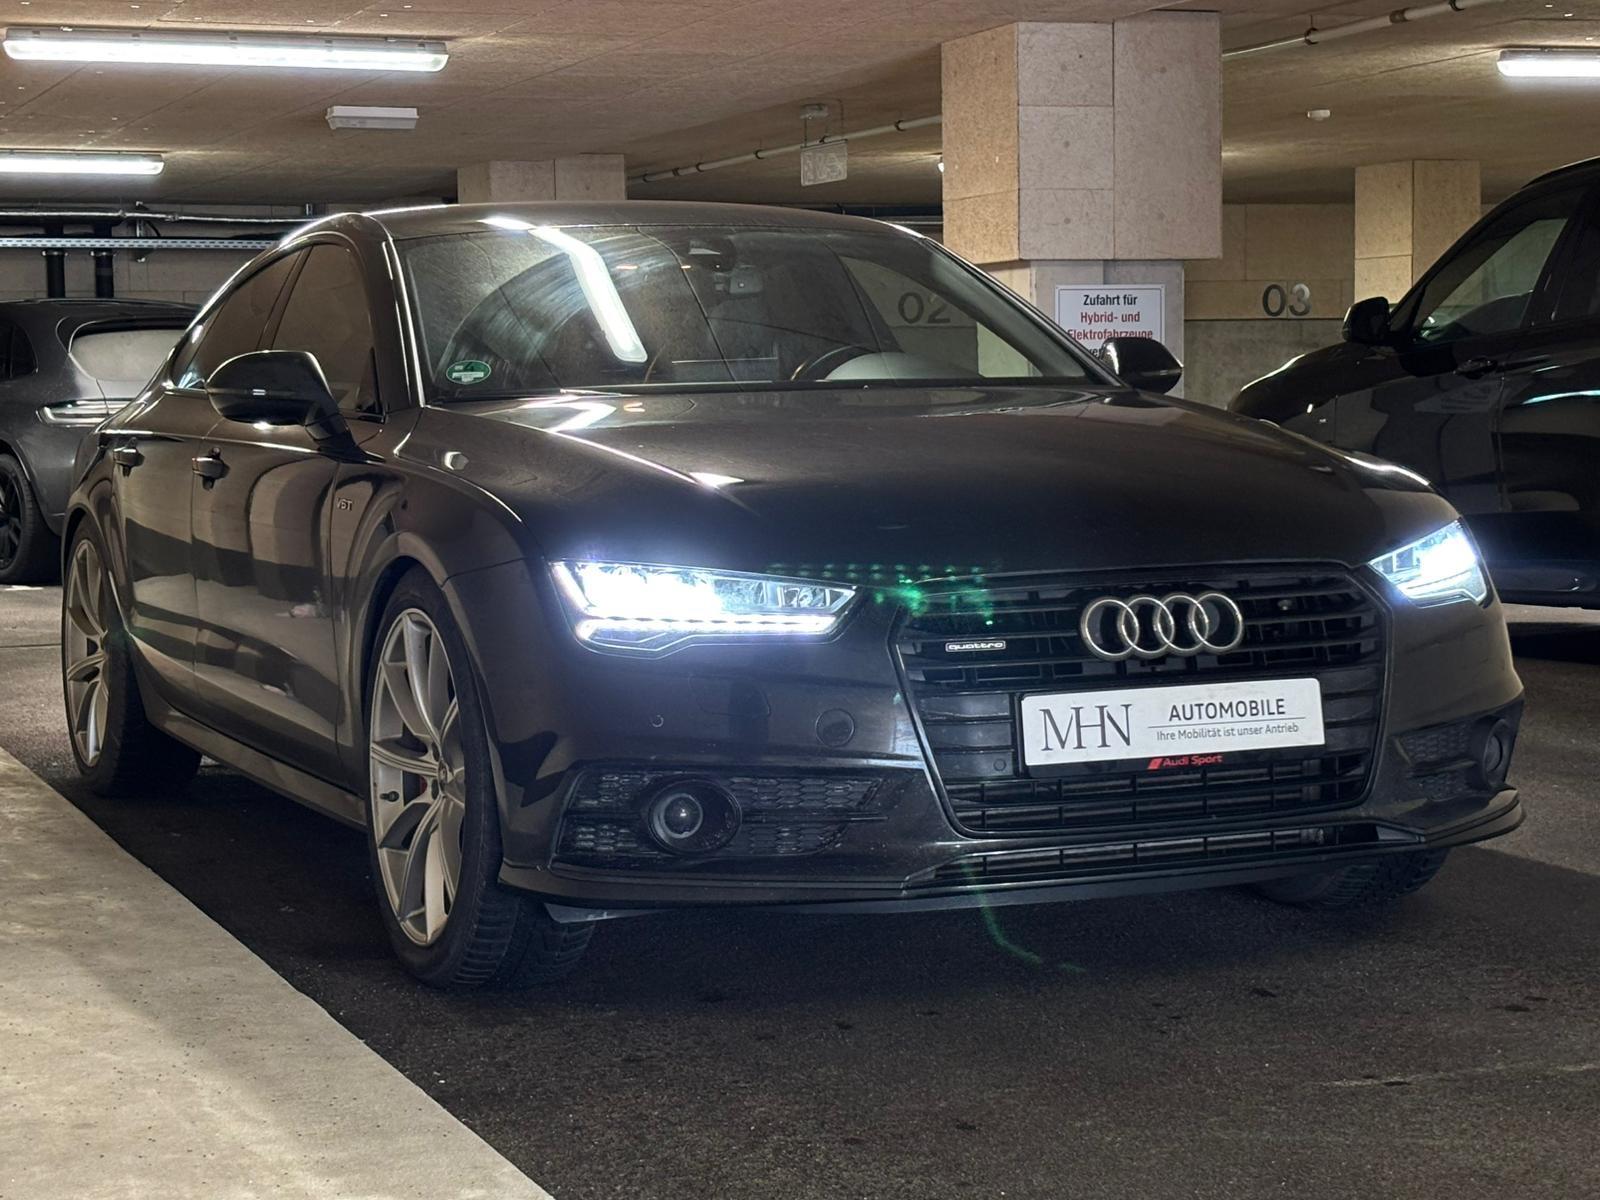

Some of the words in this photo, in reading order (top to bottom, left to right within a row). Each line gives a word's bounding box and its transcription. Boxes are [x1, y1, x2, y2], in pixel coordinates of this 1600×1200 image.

[898, 291, 951, 324] 02
[1083, 294, 1120, 306] Zufahrt
[1123, 294, 1138, 306] für
[1262, 283, 1312, 317] 03
[1080, 311, 1118, 325] Hybrid-
[1121, 311, 1140, 323] und
[948, 642, 1004, 651] quattro
[1169, 698, 1286, 722] AUTOMOBILE
[1039, 703, 1133, 751] MHN
[1156, 731, 1176, 741] Ihre
[1178, 728, 1221, 740] Mobilität
[1223, 726, 1236, 737] ist
[1238, 726, 1263, 736] unser
[1265, 722, 1299, 735] Antrieb
[1163, 756, 1189, 767] Audi
[1191, 754, 1223, 766] Sport
